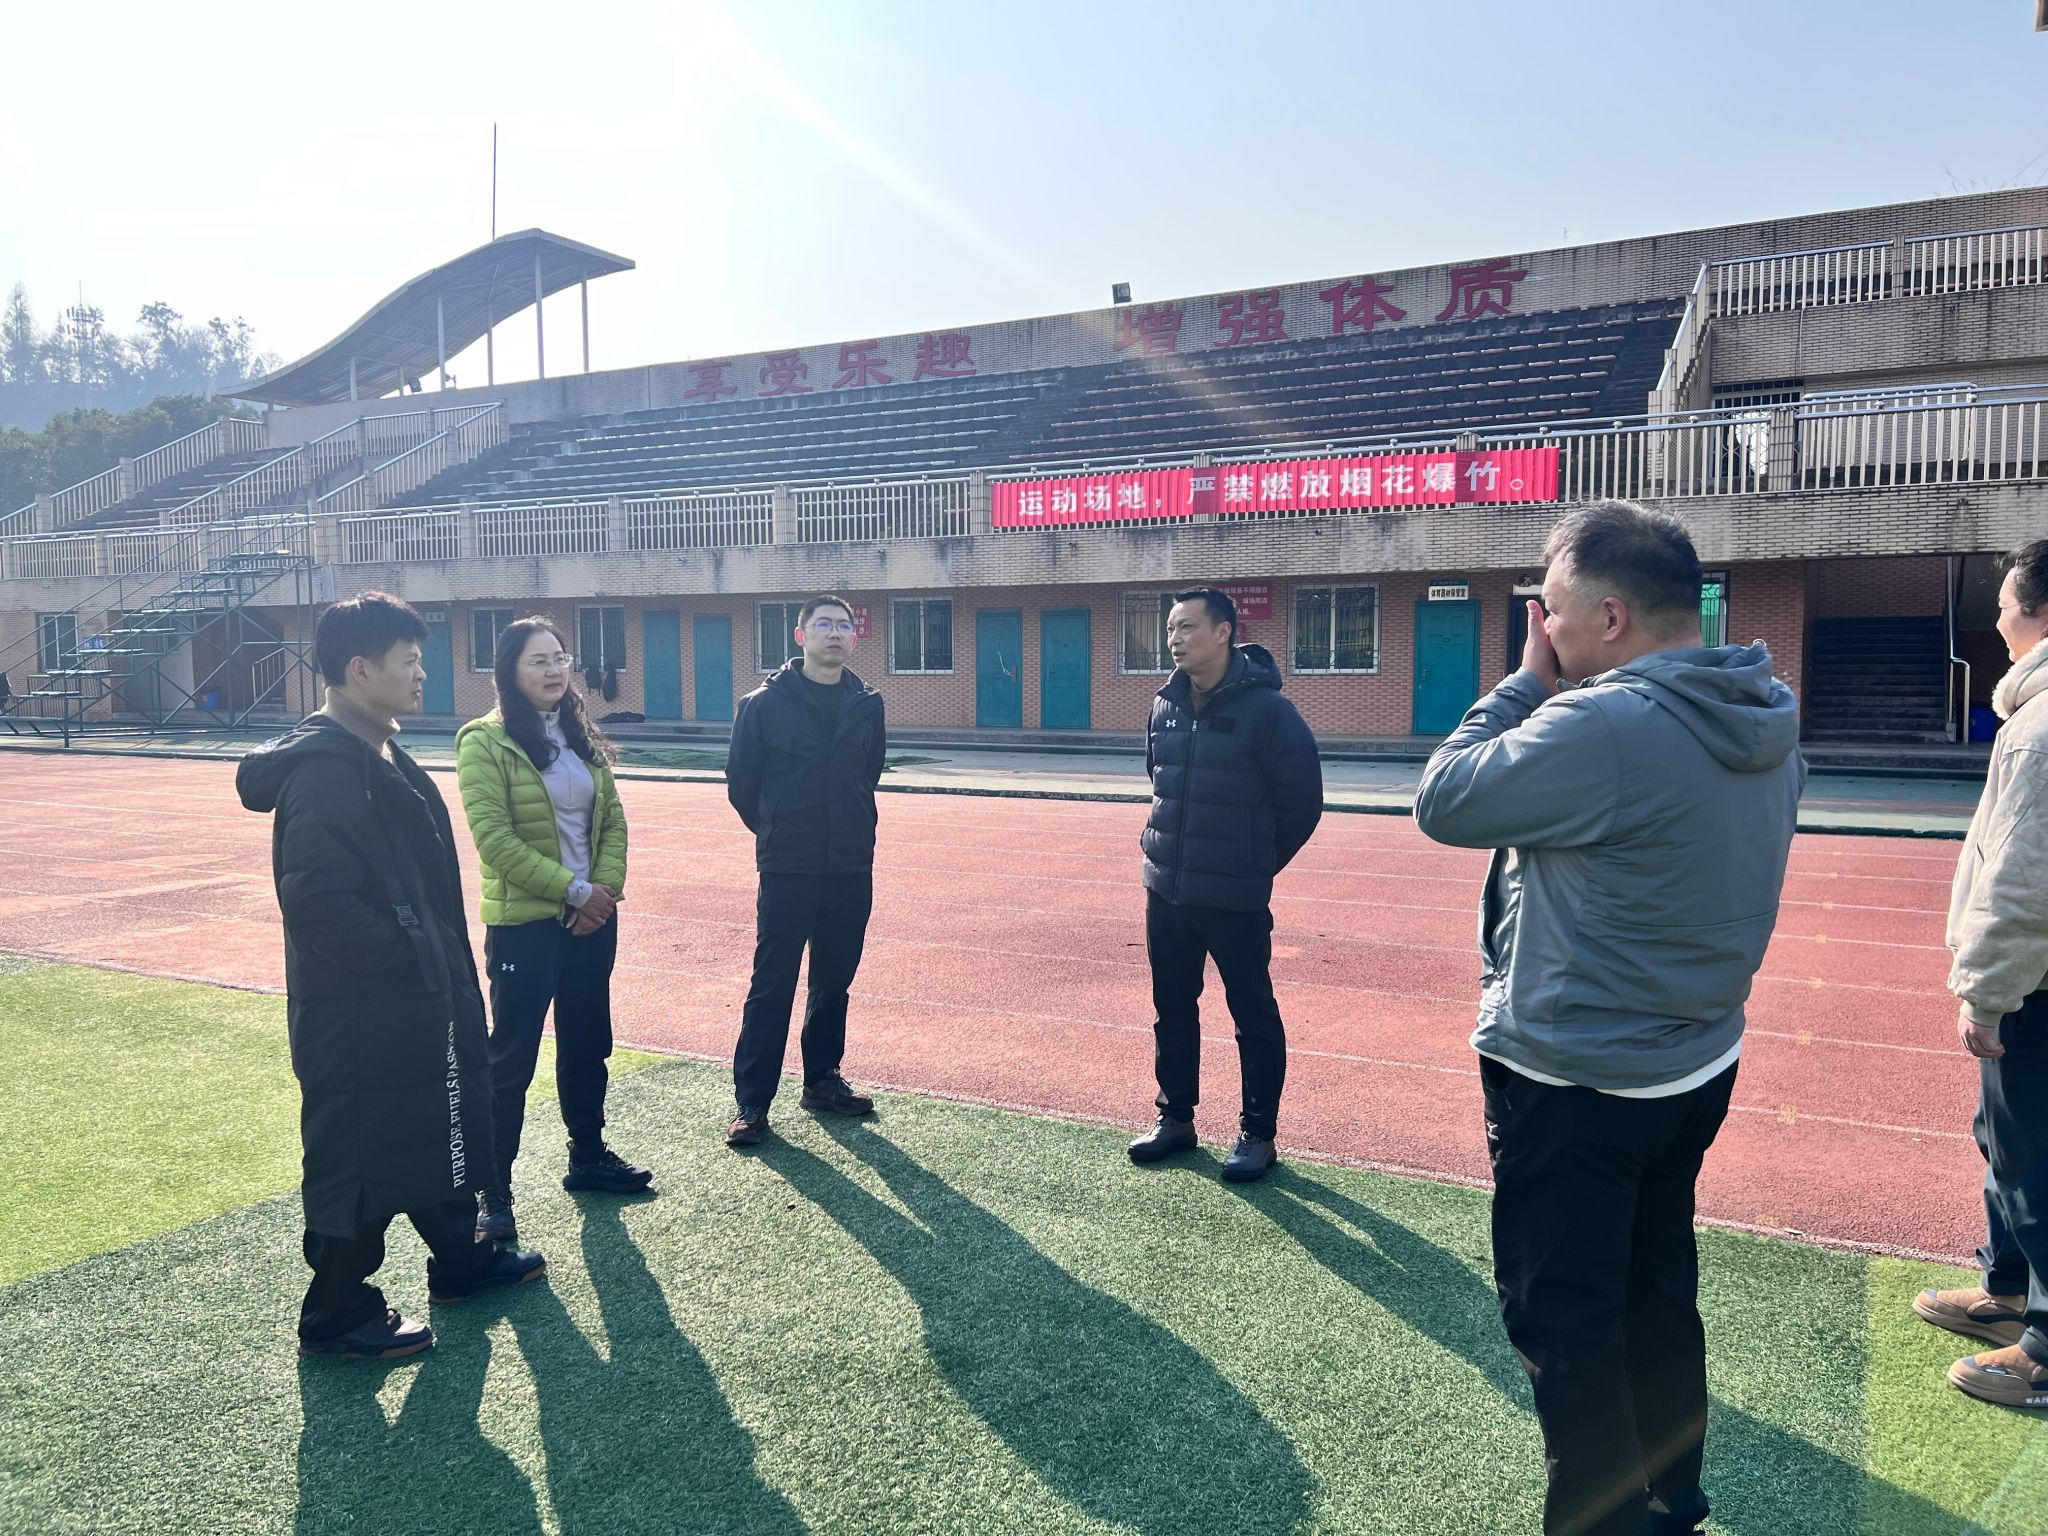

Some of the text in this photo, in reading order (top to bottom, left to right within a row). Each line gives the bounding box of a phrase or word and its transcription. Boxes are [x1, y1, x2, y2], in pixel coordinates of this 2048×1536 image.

[684, 259, 1527, 402] 享受乐趣 增强体质
[1018, 461, 1524, 516] 运动场地，严禁燃放烟花爆竹。
